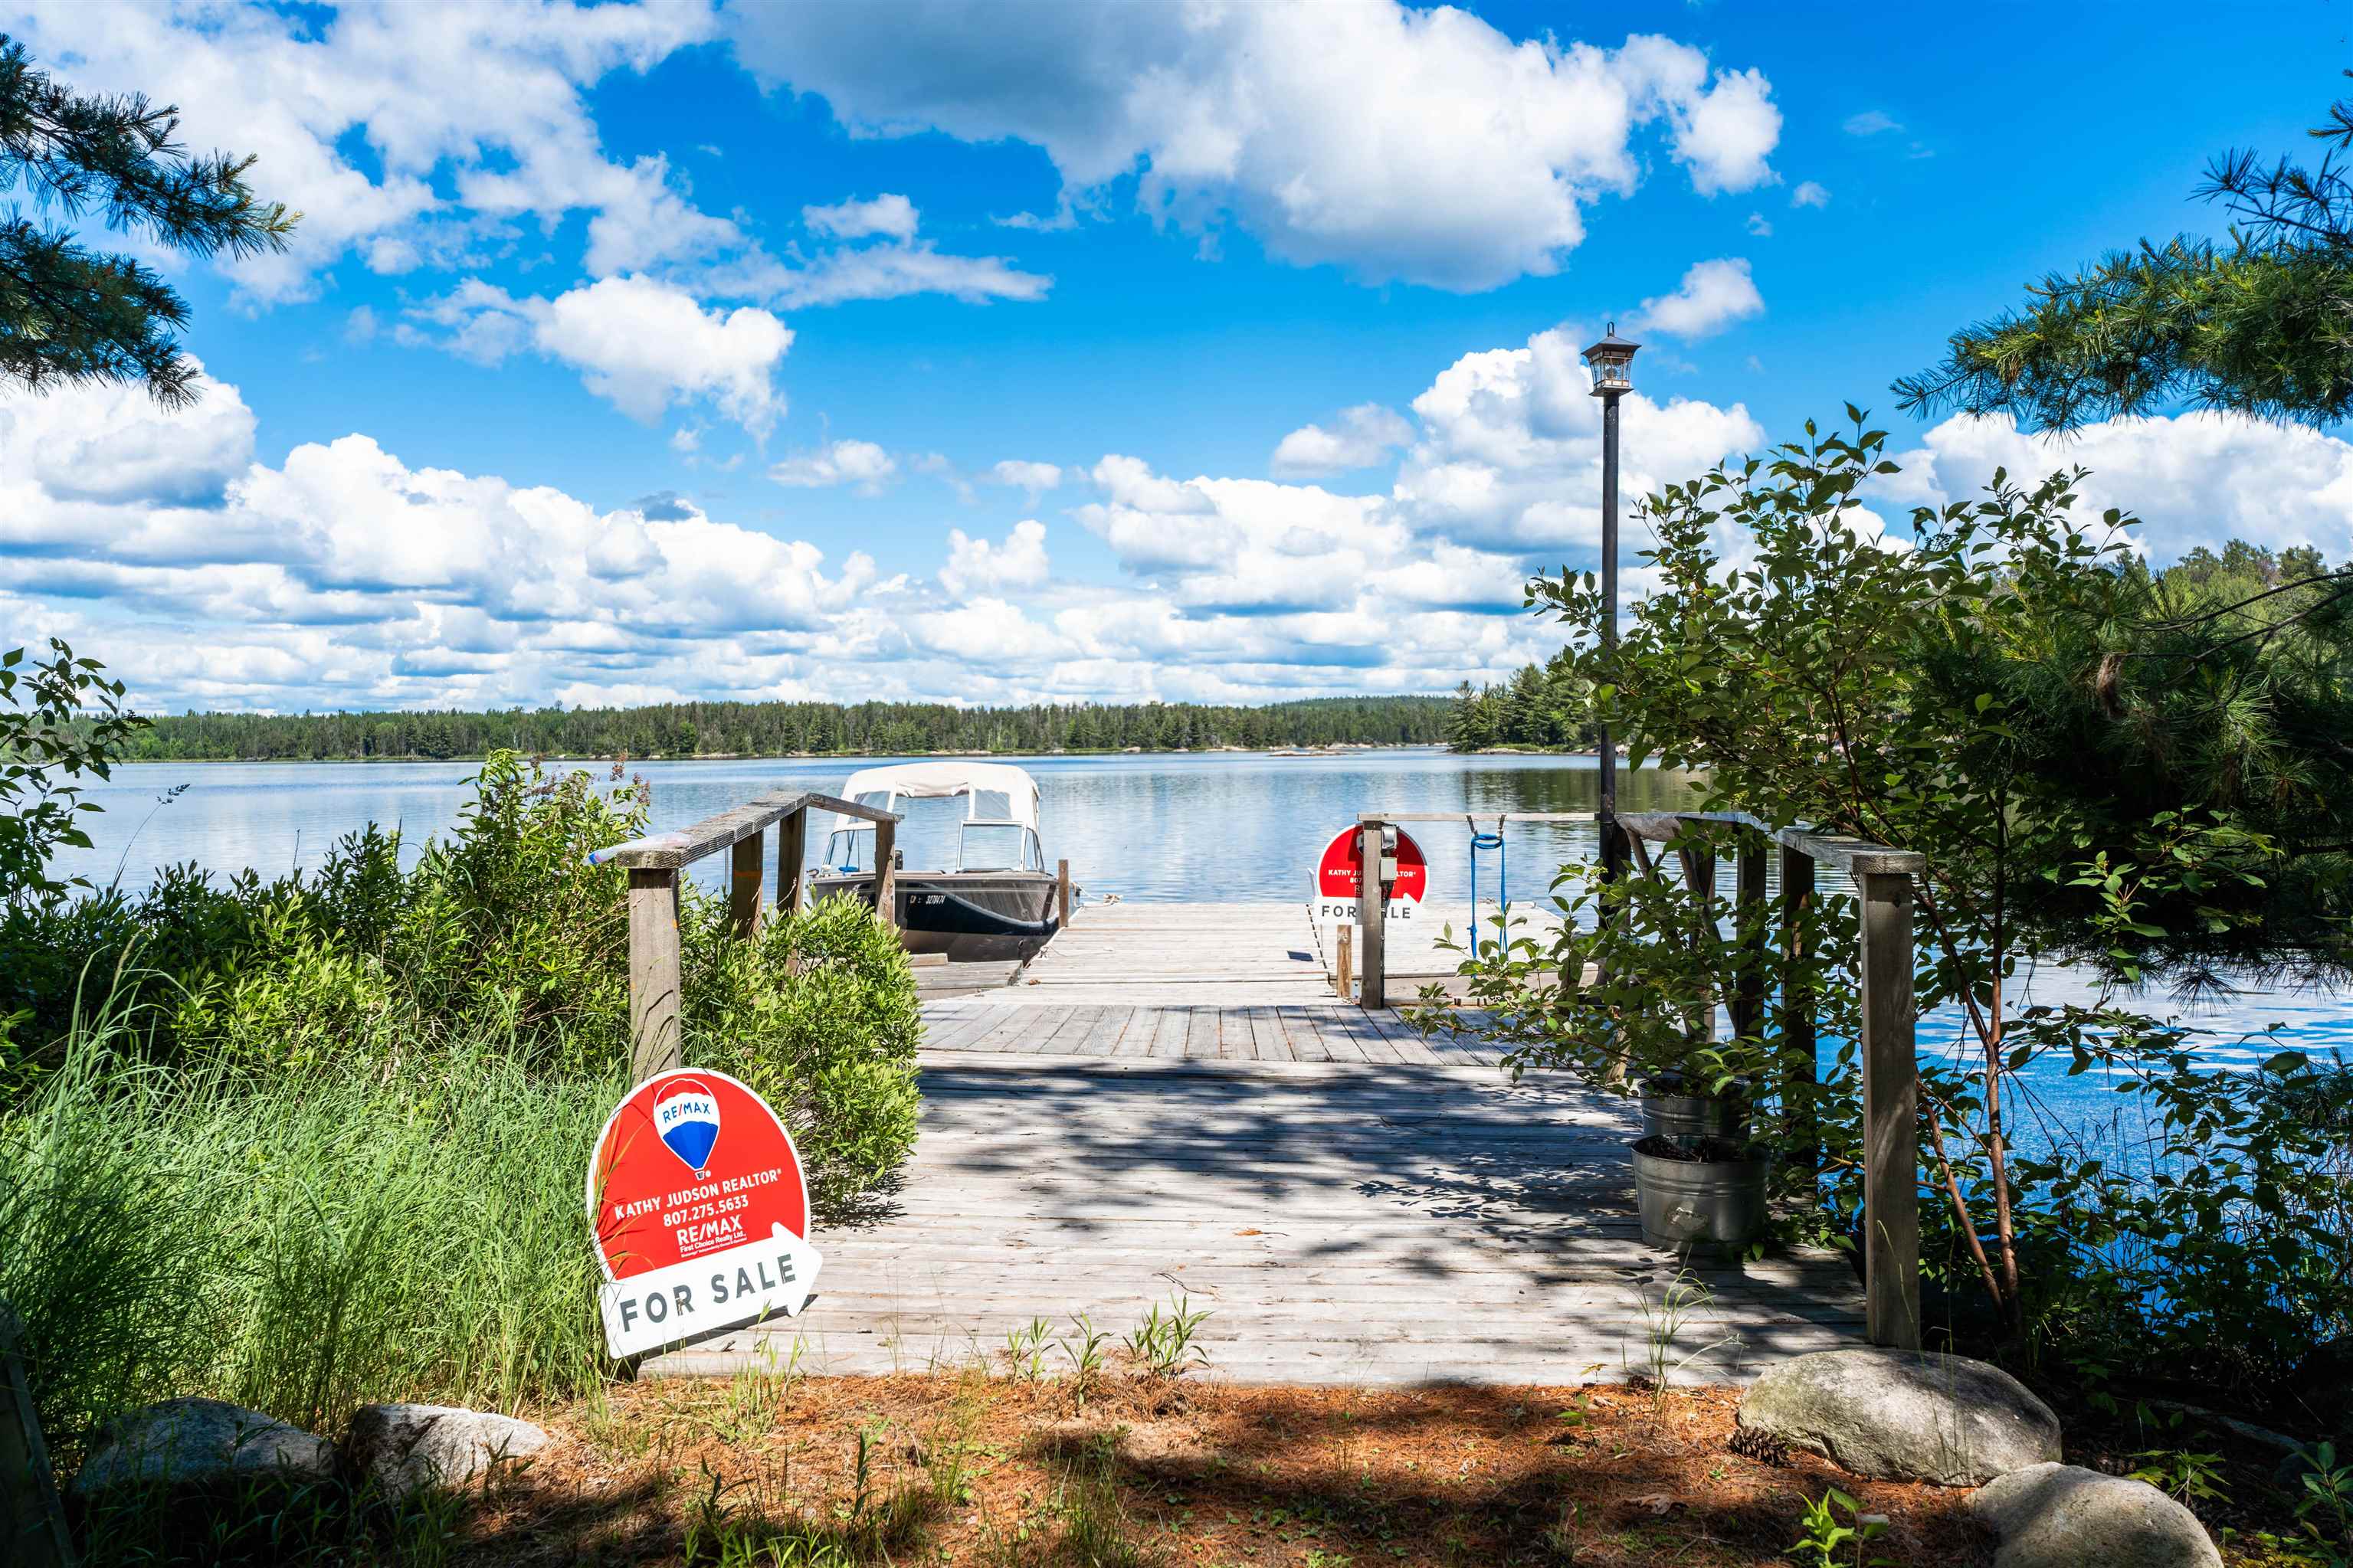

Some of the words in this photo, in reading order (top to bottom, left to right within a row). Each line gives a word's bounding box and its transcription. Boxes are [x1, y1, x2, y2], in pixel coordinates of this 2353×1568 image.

[1322, 905, 1357, 918] FOR
[663, 1102, 711, 1124] RE/MAX
[614, 1196, 661, 1220] KATHY
[666, 1183, 719, 1208] JUDSON
[663, 1194, 749, 1227] 807.275.5633
[676, 1214, 743, 1246] RE/MAX
[680, 1244, 694, 1253] First
[694, 1239, 715, 1249] Choice
[715, 1234, 732, 1245] Realty
[619, 1284, 695, 1333] FOR
[710, 1253, 796, 1304] SALE
